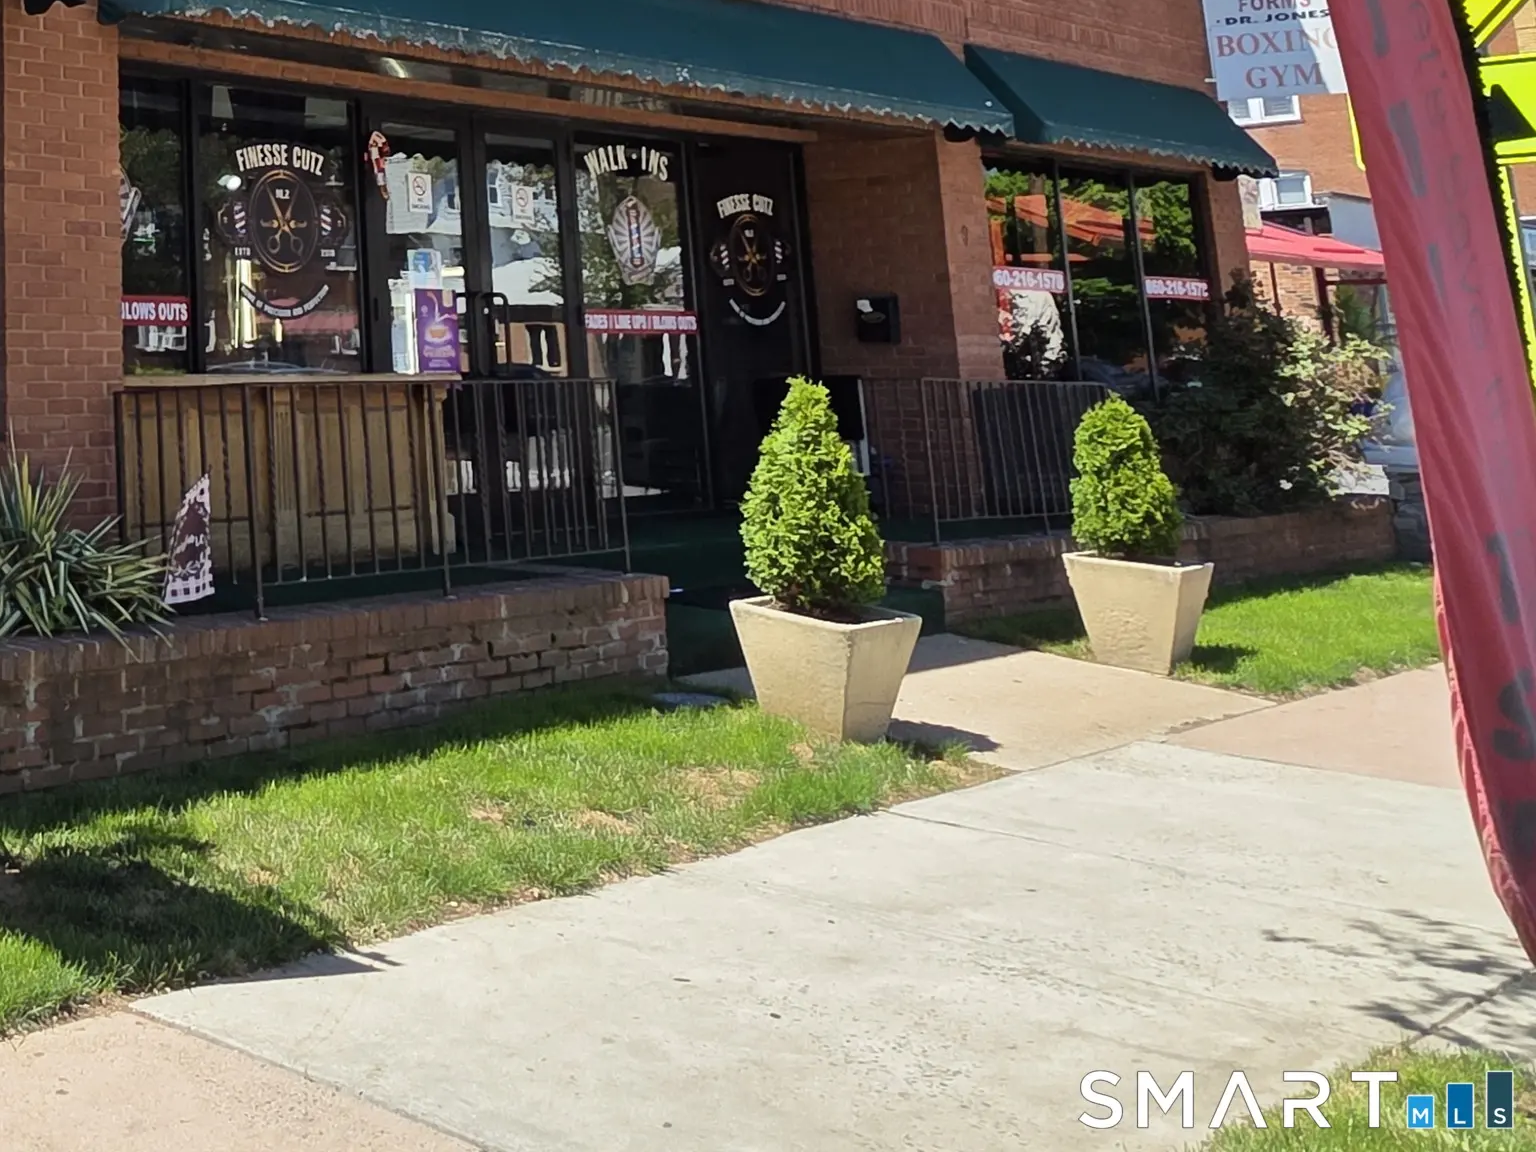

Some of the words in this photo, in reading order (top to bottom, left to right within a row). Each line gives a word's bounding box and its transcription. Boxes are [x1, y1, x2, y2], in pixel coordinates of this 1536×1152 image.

[1265, 9, 1331, 23] JONES
[1246, 63, 1327, 90] GYM
[236, 143, 288, 172] FINESSE
[292, 146, 324, 176] CUTZ
[584, 145, 628, 176] WALK
[641, 146, 668, 181] INS
[158, 302, 188, 321] OUTS
